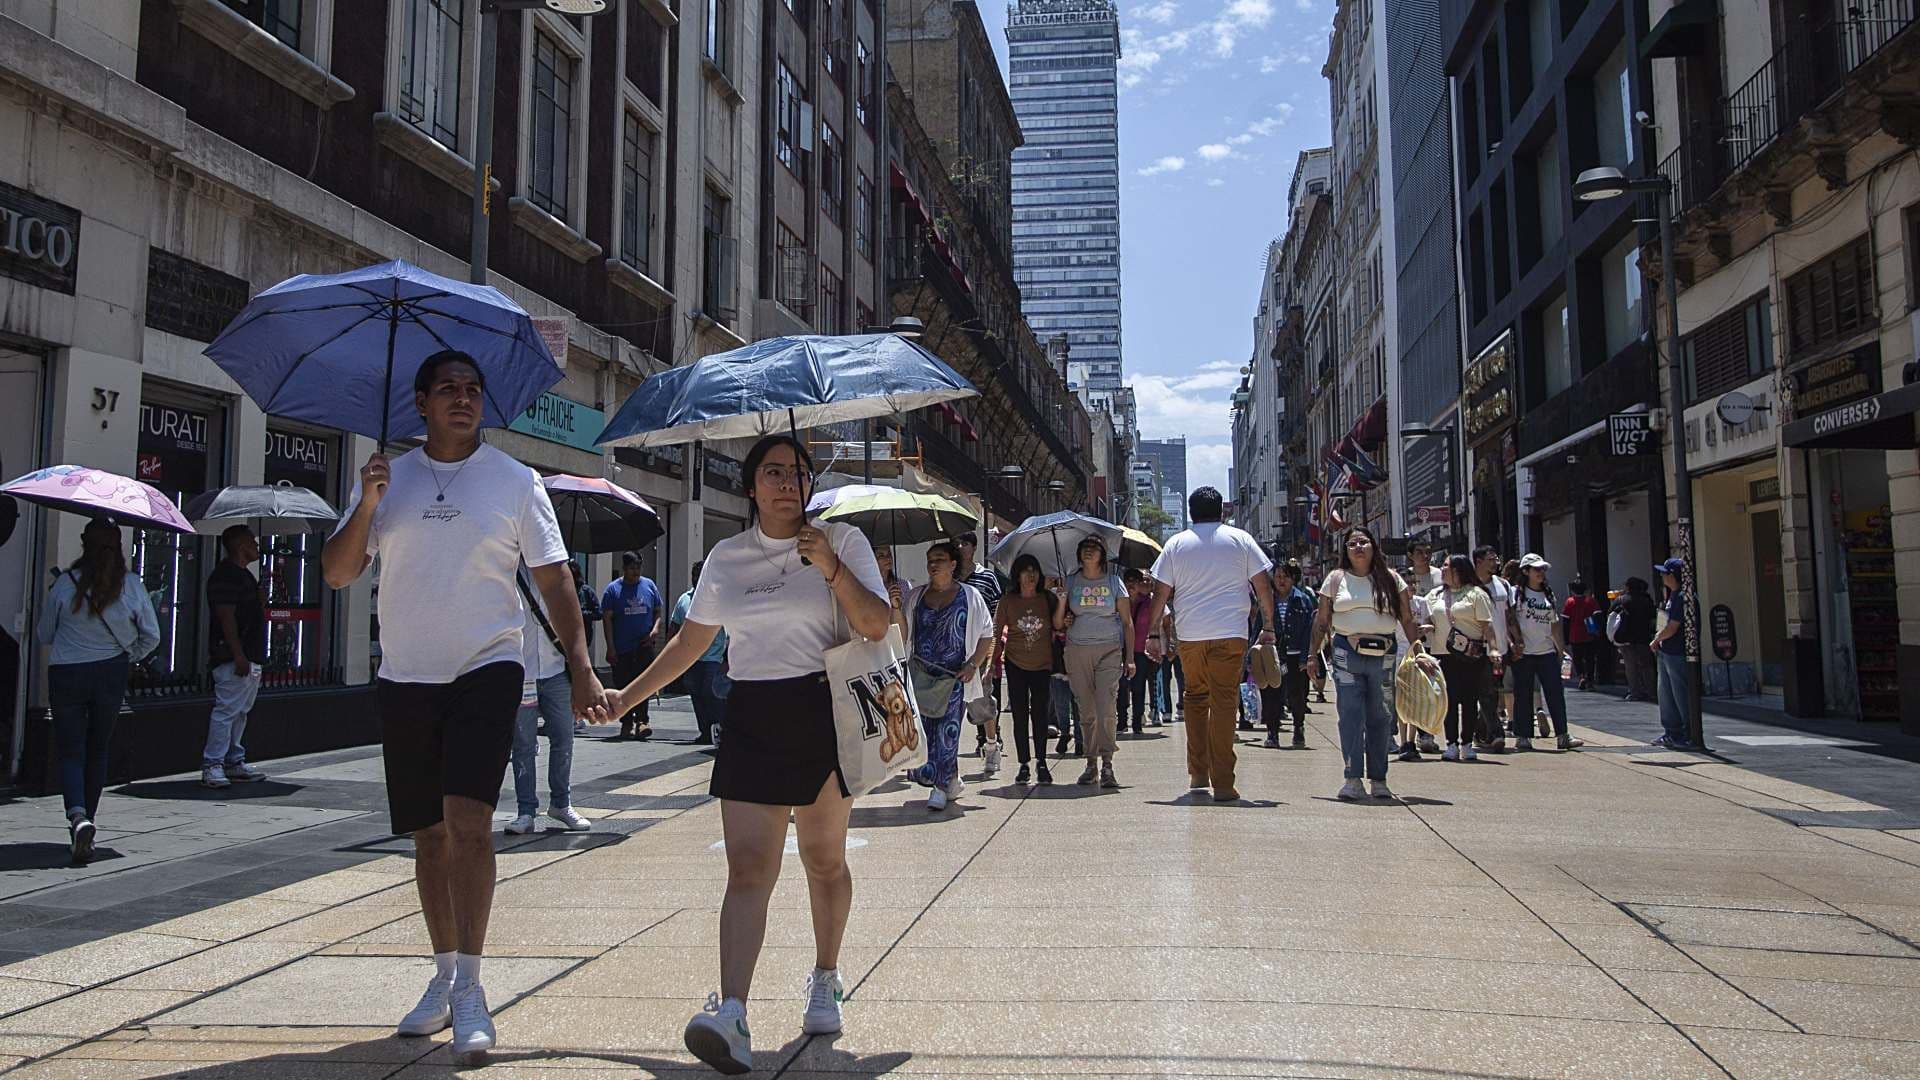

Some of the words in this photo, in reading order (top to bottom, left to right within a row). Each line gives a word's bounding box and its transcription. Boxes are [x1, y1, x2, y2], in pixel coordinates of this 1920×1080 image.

[1013, 12, 1109, 26] LATINOAMERICANA
[91, 387, 120, 412] 37
[140, 404, 208, 444] TURATI
[538, 395, 575, 432] FRAICHE
[1614, 417, 1641, 430] INN
[1814, 402, 1869, 434] CONVERSE
[274, 433, 328, 465] TURATI
[1615, 430, 1649, 443] VICT
[1616, 442, 1637, 455] US
